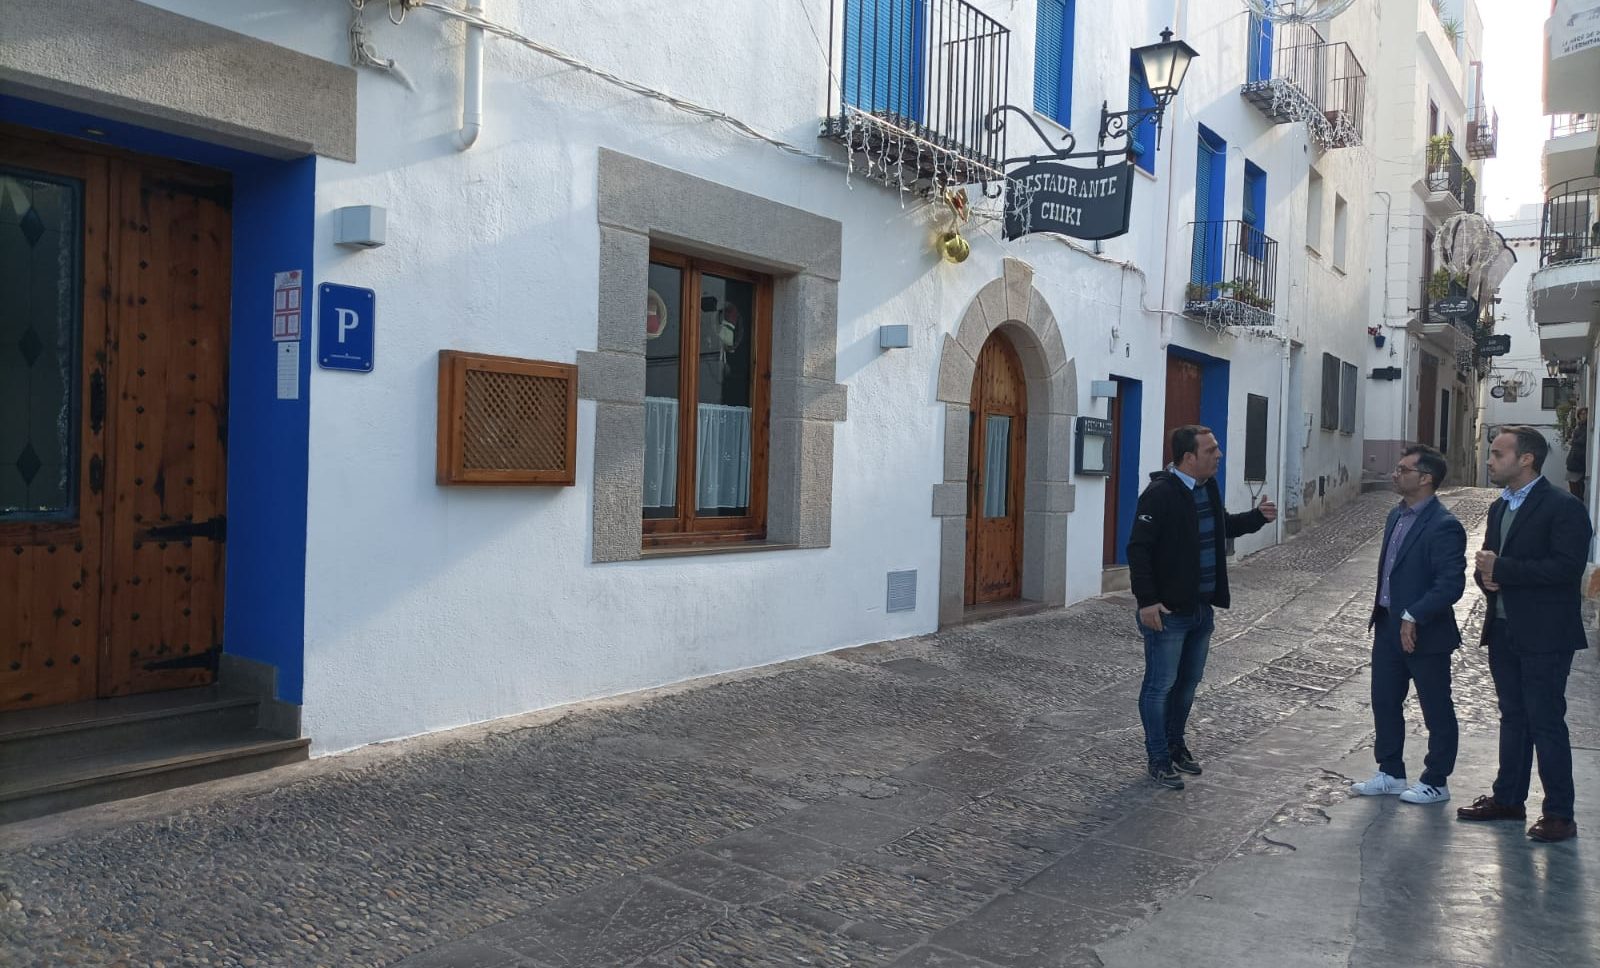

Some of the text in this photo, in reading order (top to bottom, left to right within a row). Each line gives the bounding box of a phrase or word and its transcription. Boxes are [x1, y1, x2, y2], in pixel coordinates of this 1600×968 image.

[1016, 173, 1118, 198] RESTAURANTE
[1041, 202, 1082, 226] CHIKI
[335, 307, 359, 343] P
